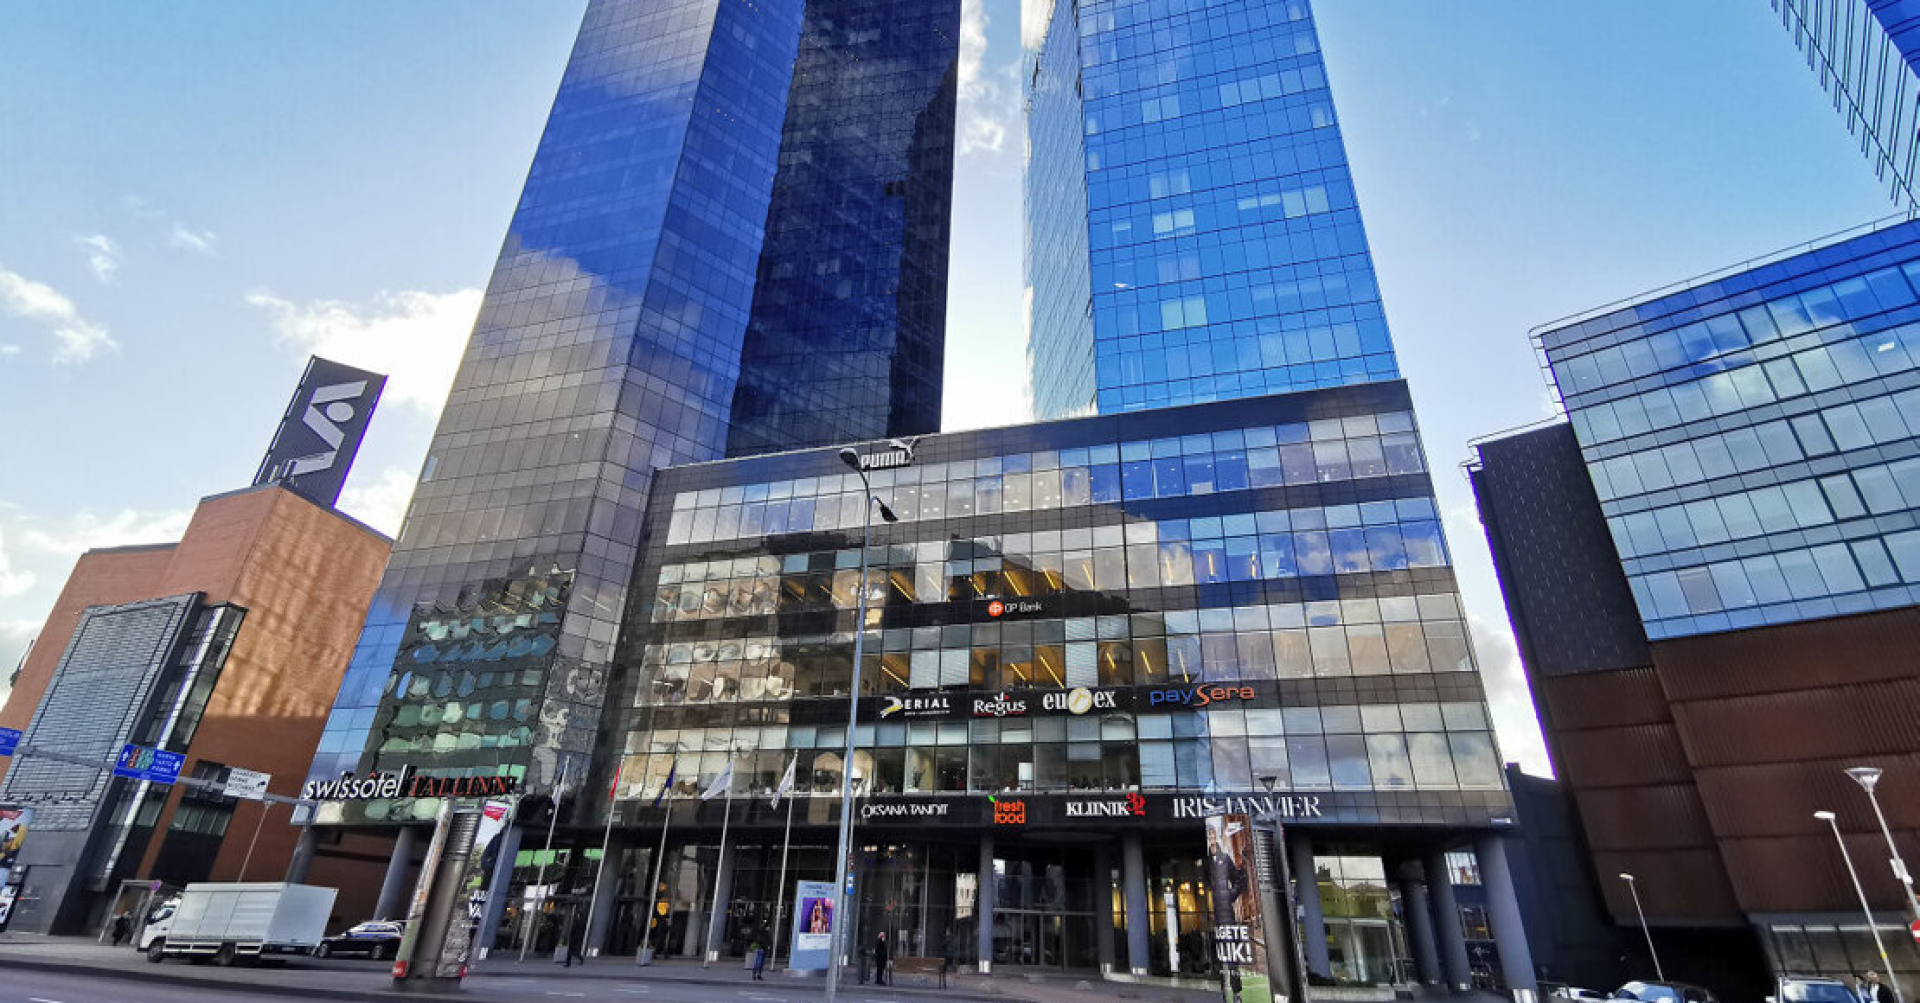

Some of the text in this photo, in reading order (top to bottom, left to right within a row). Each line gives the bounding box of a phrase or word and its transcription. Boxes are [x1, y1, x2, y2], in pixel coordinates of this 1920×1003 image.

[860, 450, 906, 470] PUMA
[1004, 601, 1042, 613] OP Bank
[973, 695, 1027, 716] Regus
[303, 764, 512, 799] swissôtel TALLINN
[861, 803, 949, 818] OKSANA TANDIT
[994, 799, 1025, 812] fresh
[1066, 792, 1146, 816] KLIINIK 32
[1173, 796, 1223, 817] IRIS
[994, 811, 1025, 824] food
